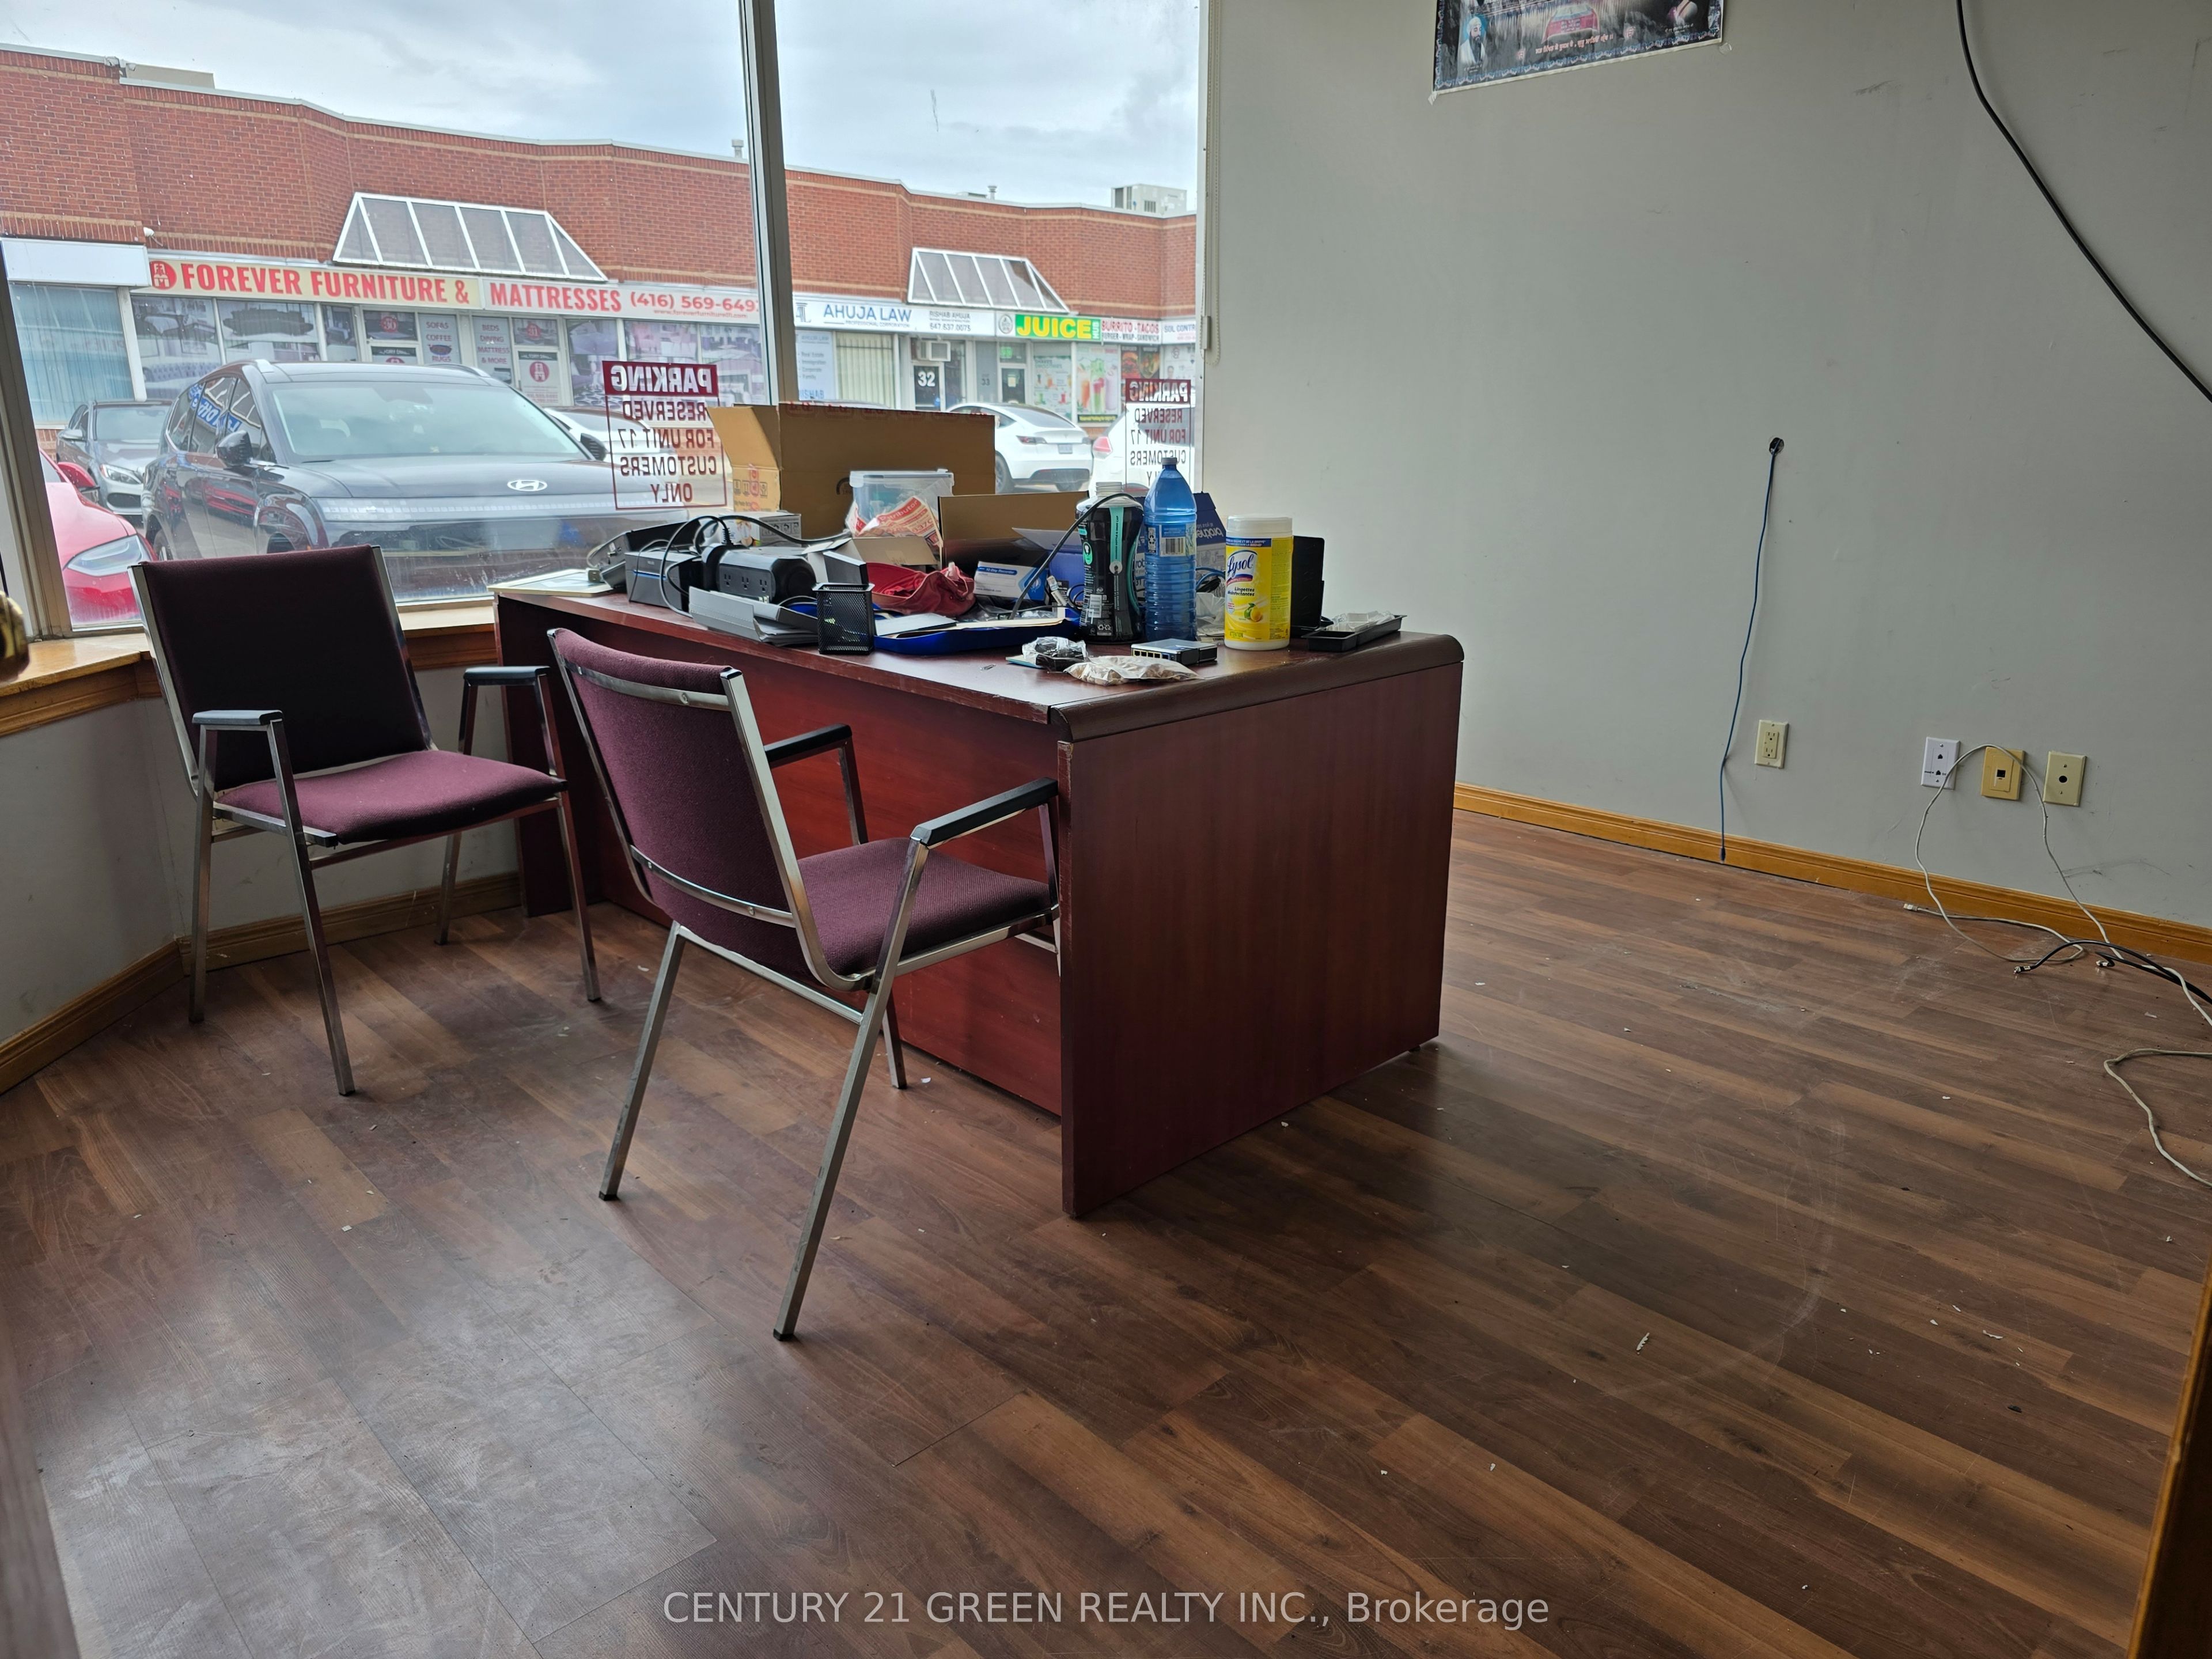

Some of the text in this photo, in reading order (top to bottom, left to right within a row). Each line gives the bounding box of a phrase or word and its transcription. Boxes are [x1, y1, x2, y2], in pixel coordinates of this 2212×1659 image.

[180, 263, 302, 295] FOREVER
[310, 271, 447, 303] FURNITURE
[455, 279, 469, 304] &
[490, 282, 622, 312] MATTRESSES
[630, 291, 675, 309] (416)
[681, 296, 759, 313] 569-649
[824, 304, 912, 323] AHUJA LAW
[1017, 316, 1092, 339] JUICE
[1101, 320, 1132, 332] BURRITO
[1137, 322, 1159, 334] TACOS
[918, 371, 935, 387] 32
[1196, 527, 1224, 539] brothe
[1228, 554, 1254, 579] Lysol
